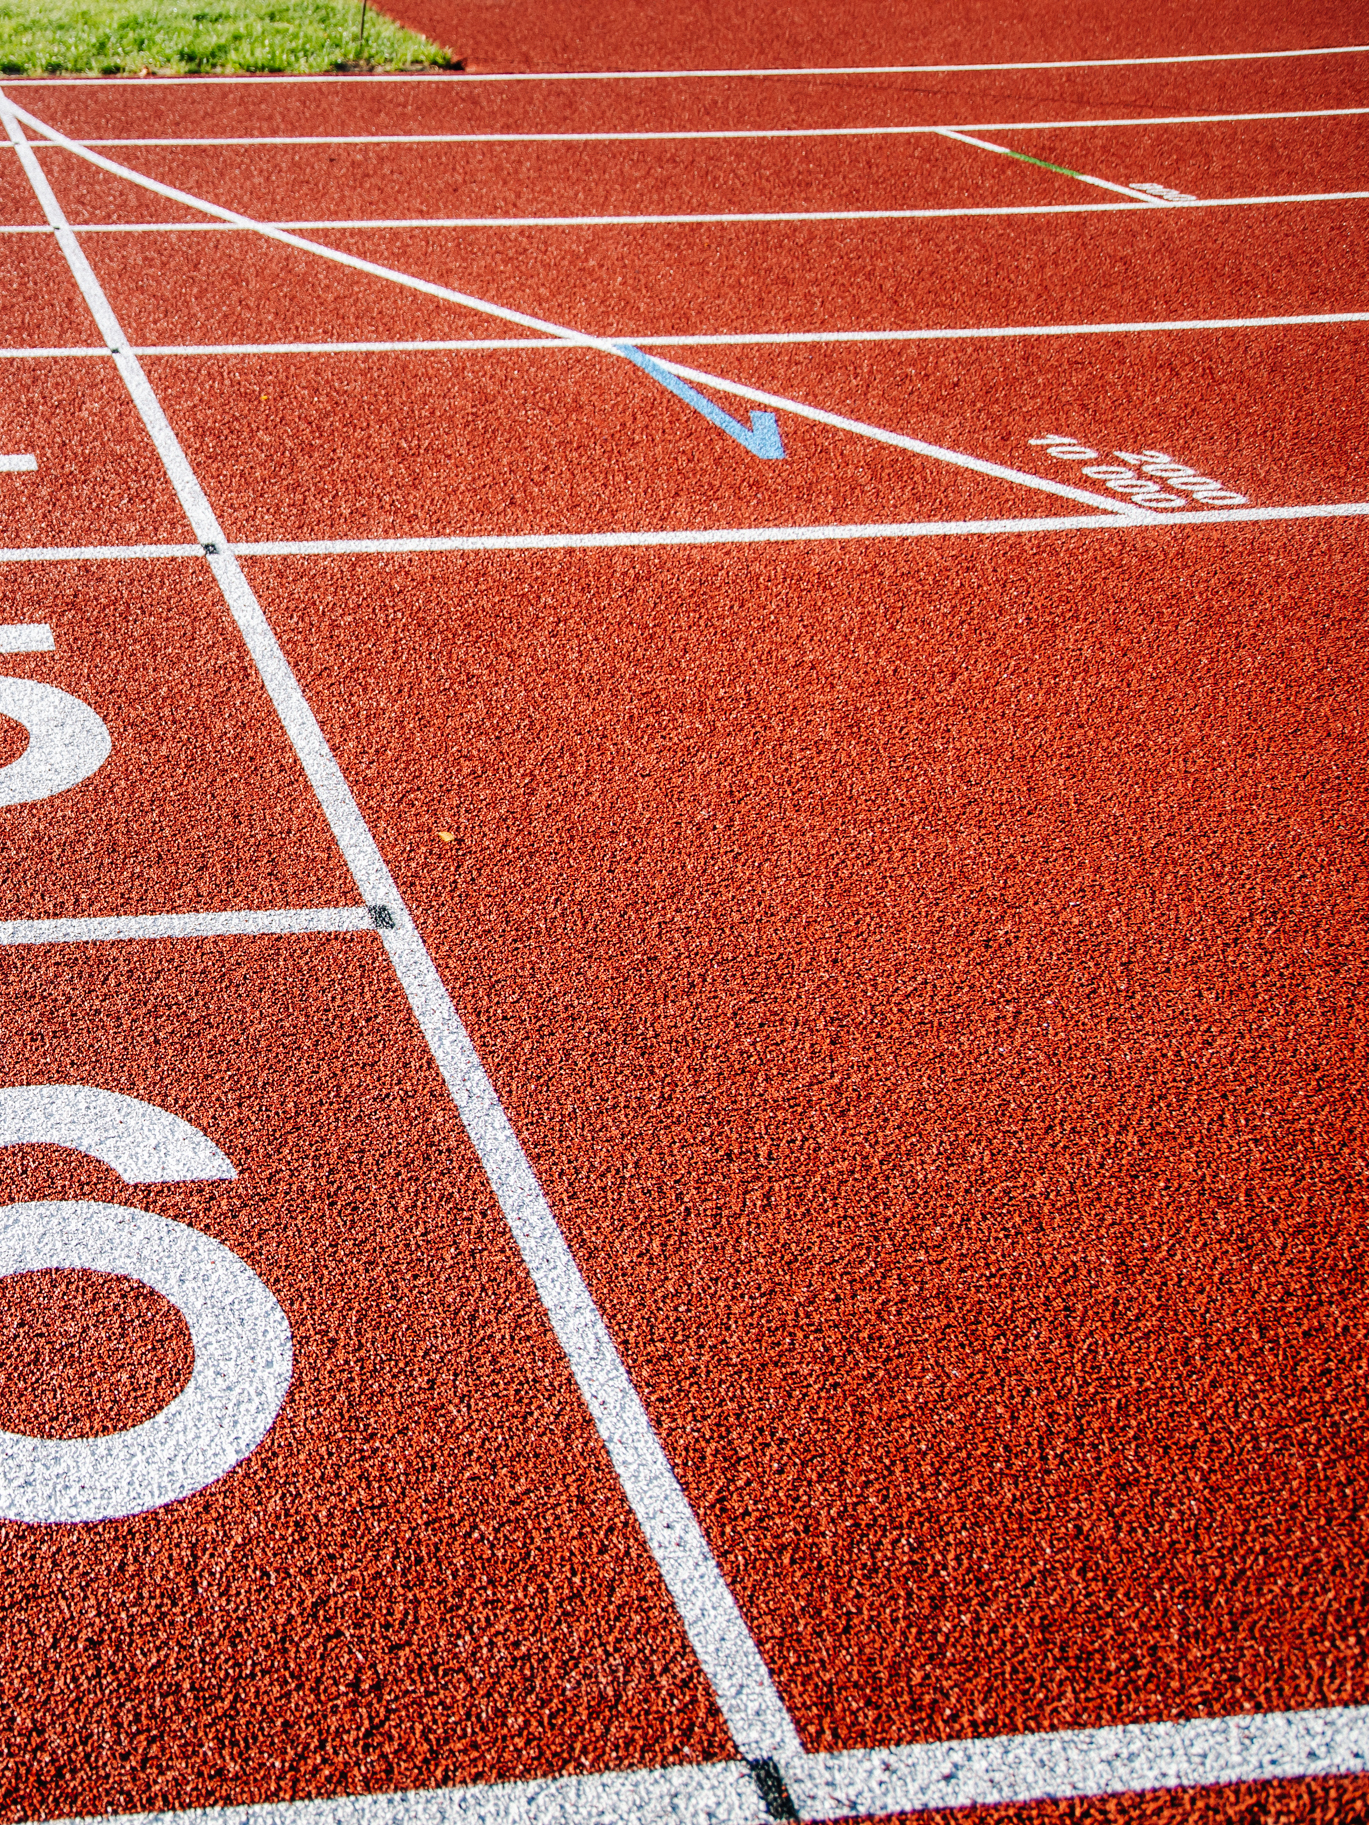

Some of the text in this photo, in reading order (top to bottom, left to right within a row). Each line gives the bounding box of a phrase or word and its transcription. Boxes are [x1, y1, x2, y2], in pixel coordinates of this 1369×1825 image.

[1027, 433, 1188, 508] 10 000
[1113, 449, 1250, 506] 2000
